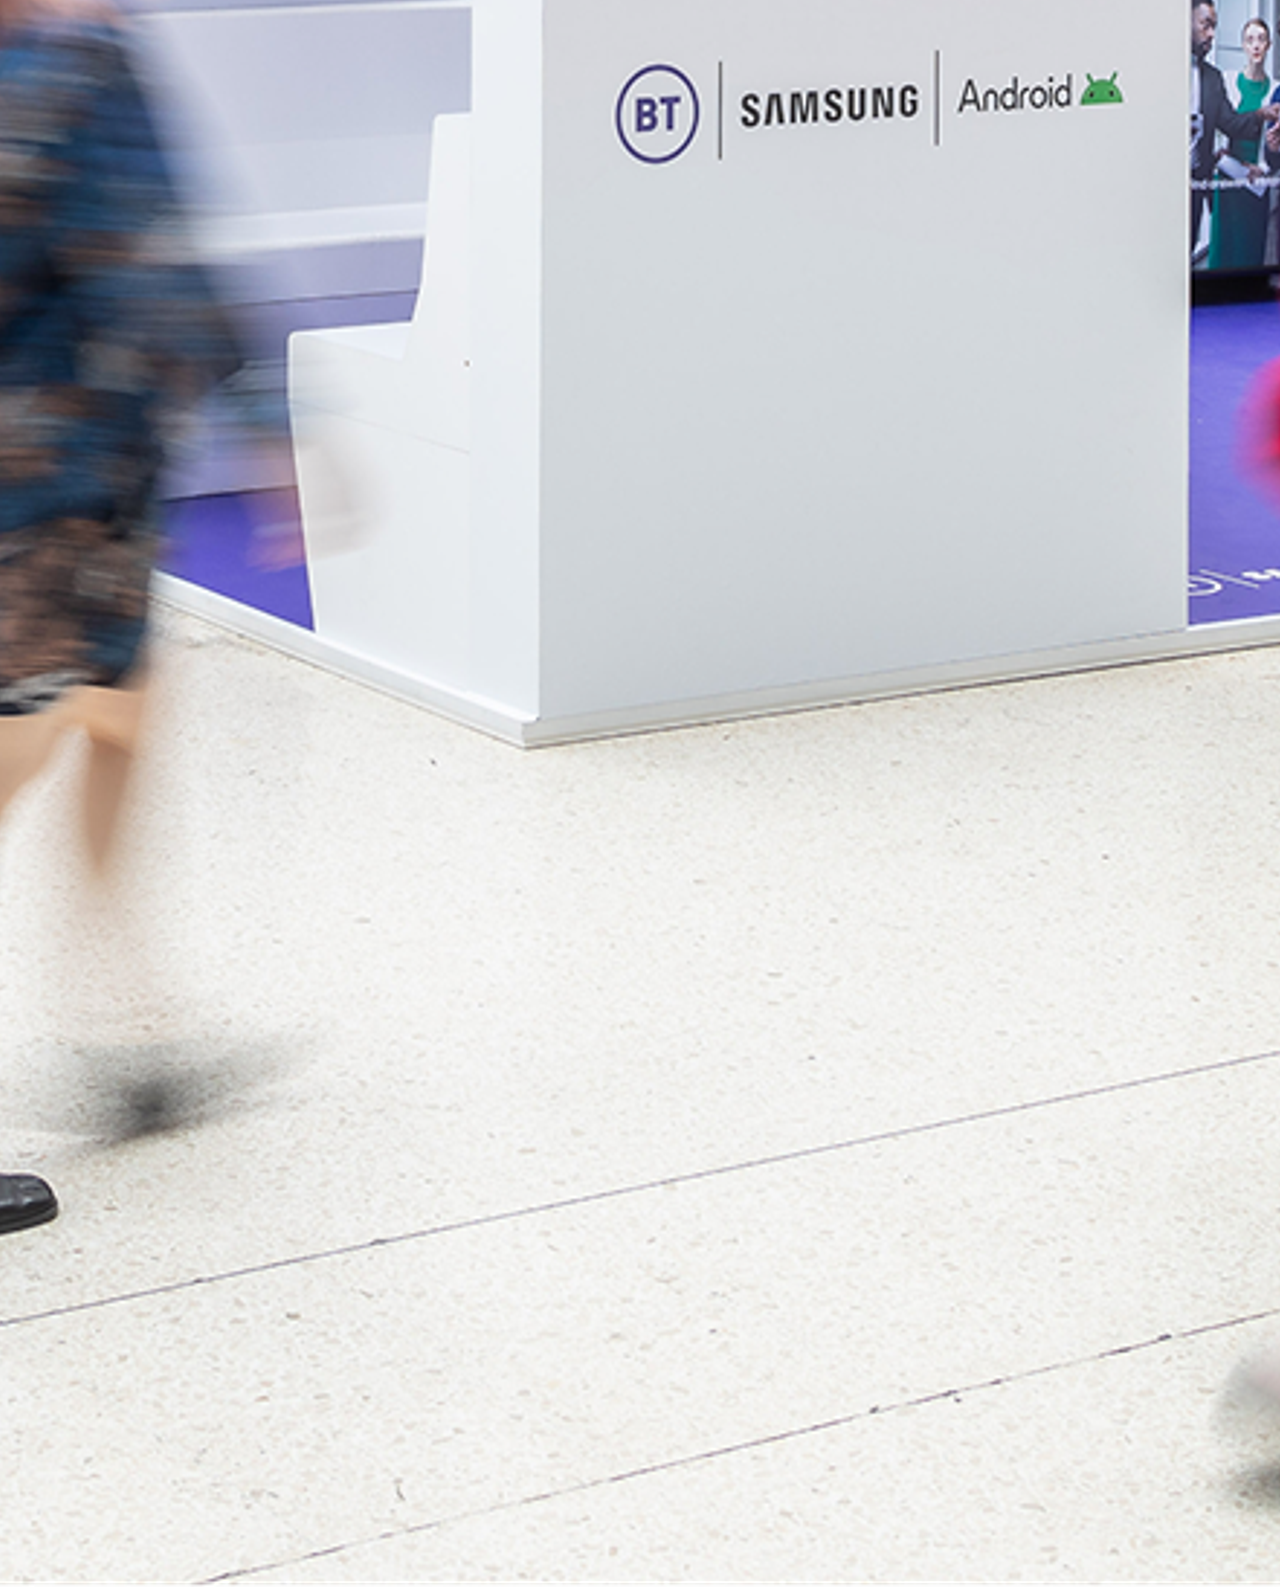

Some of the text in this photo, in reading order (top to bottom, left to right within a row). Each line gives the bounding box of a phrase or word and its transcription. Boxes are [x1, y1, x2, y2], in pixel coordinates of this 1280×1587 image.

[635, 74, 1072, 132] BT SAMSUNG Android
